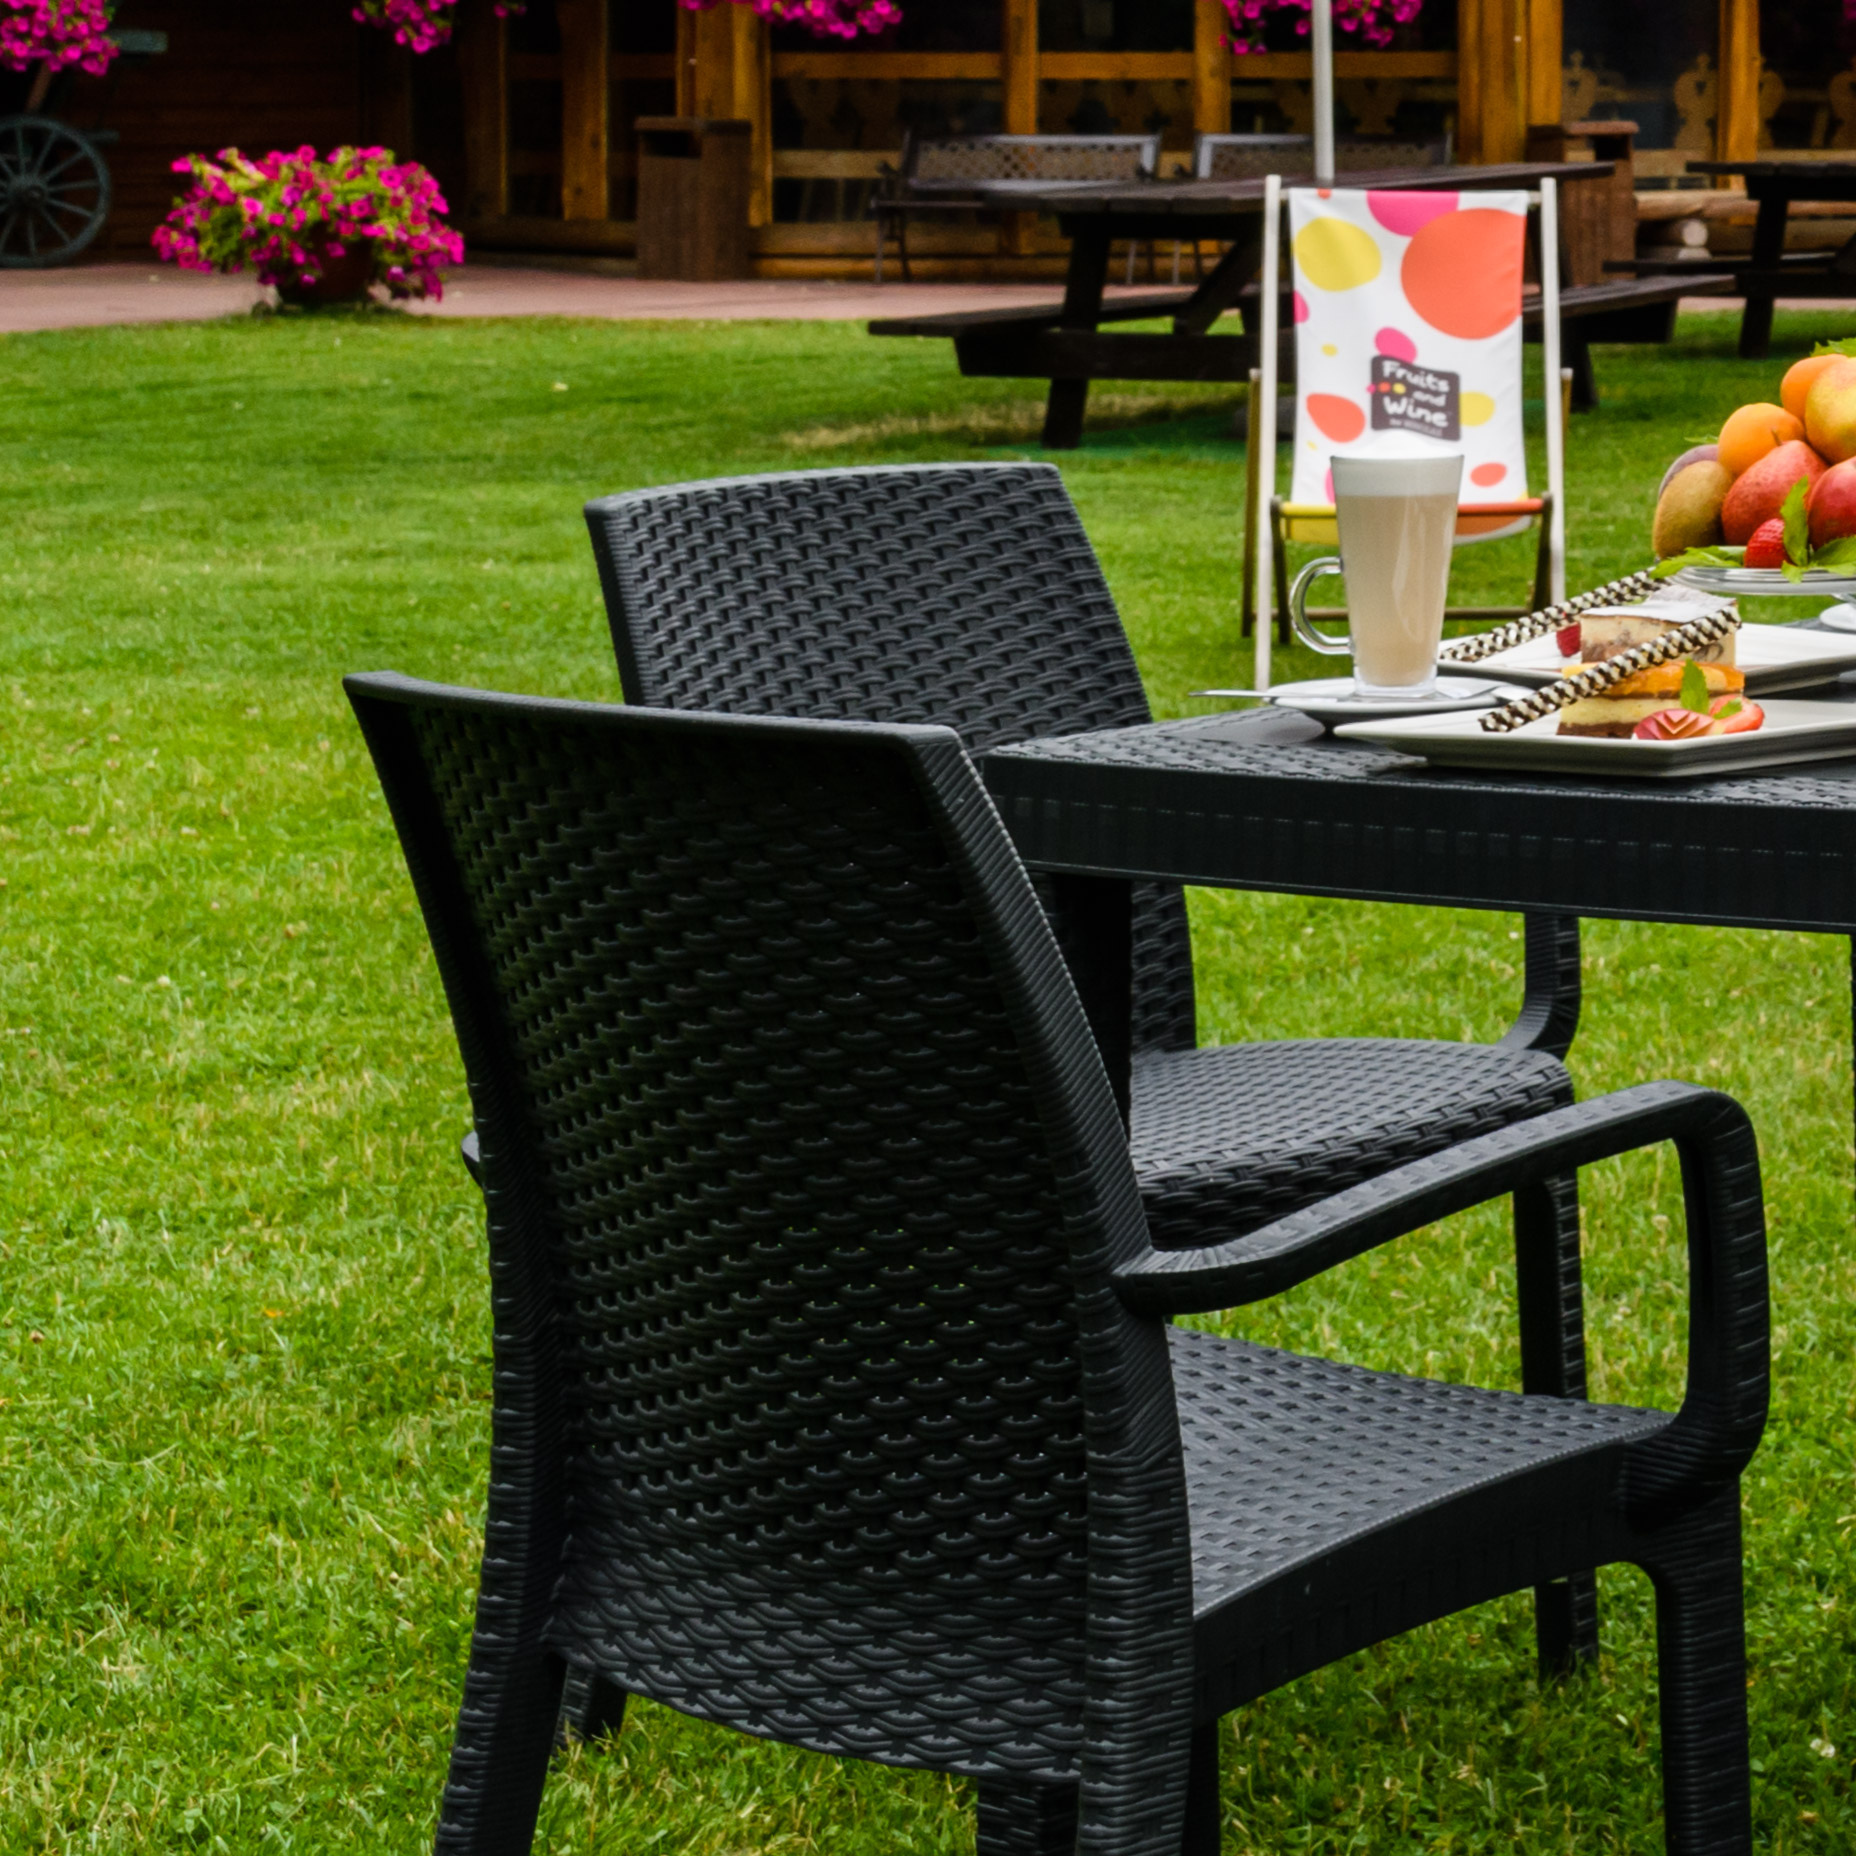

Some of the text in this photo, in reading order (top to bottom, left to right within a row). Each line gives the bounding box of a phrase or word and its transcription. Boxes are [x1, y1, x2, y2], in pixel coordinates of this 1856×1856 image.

[1382, 359, 1450, 393] Fruits
[1383, 395, 1449, 428] Wine
[1412, 390, 1447, 407] and
